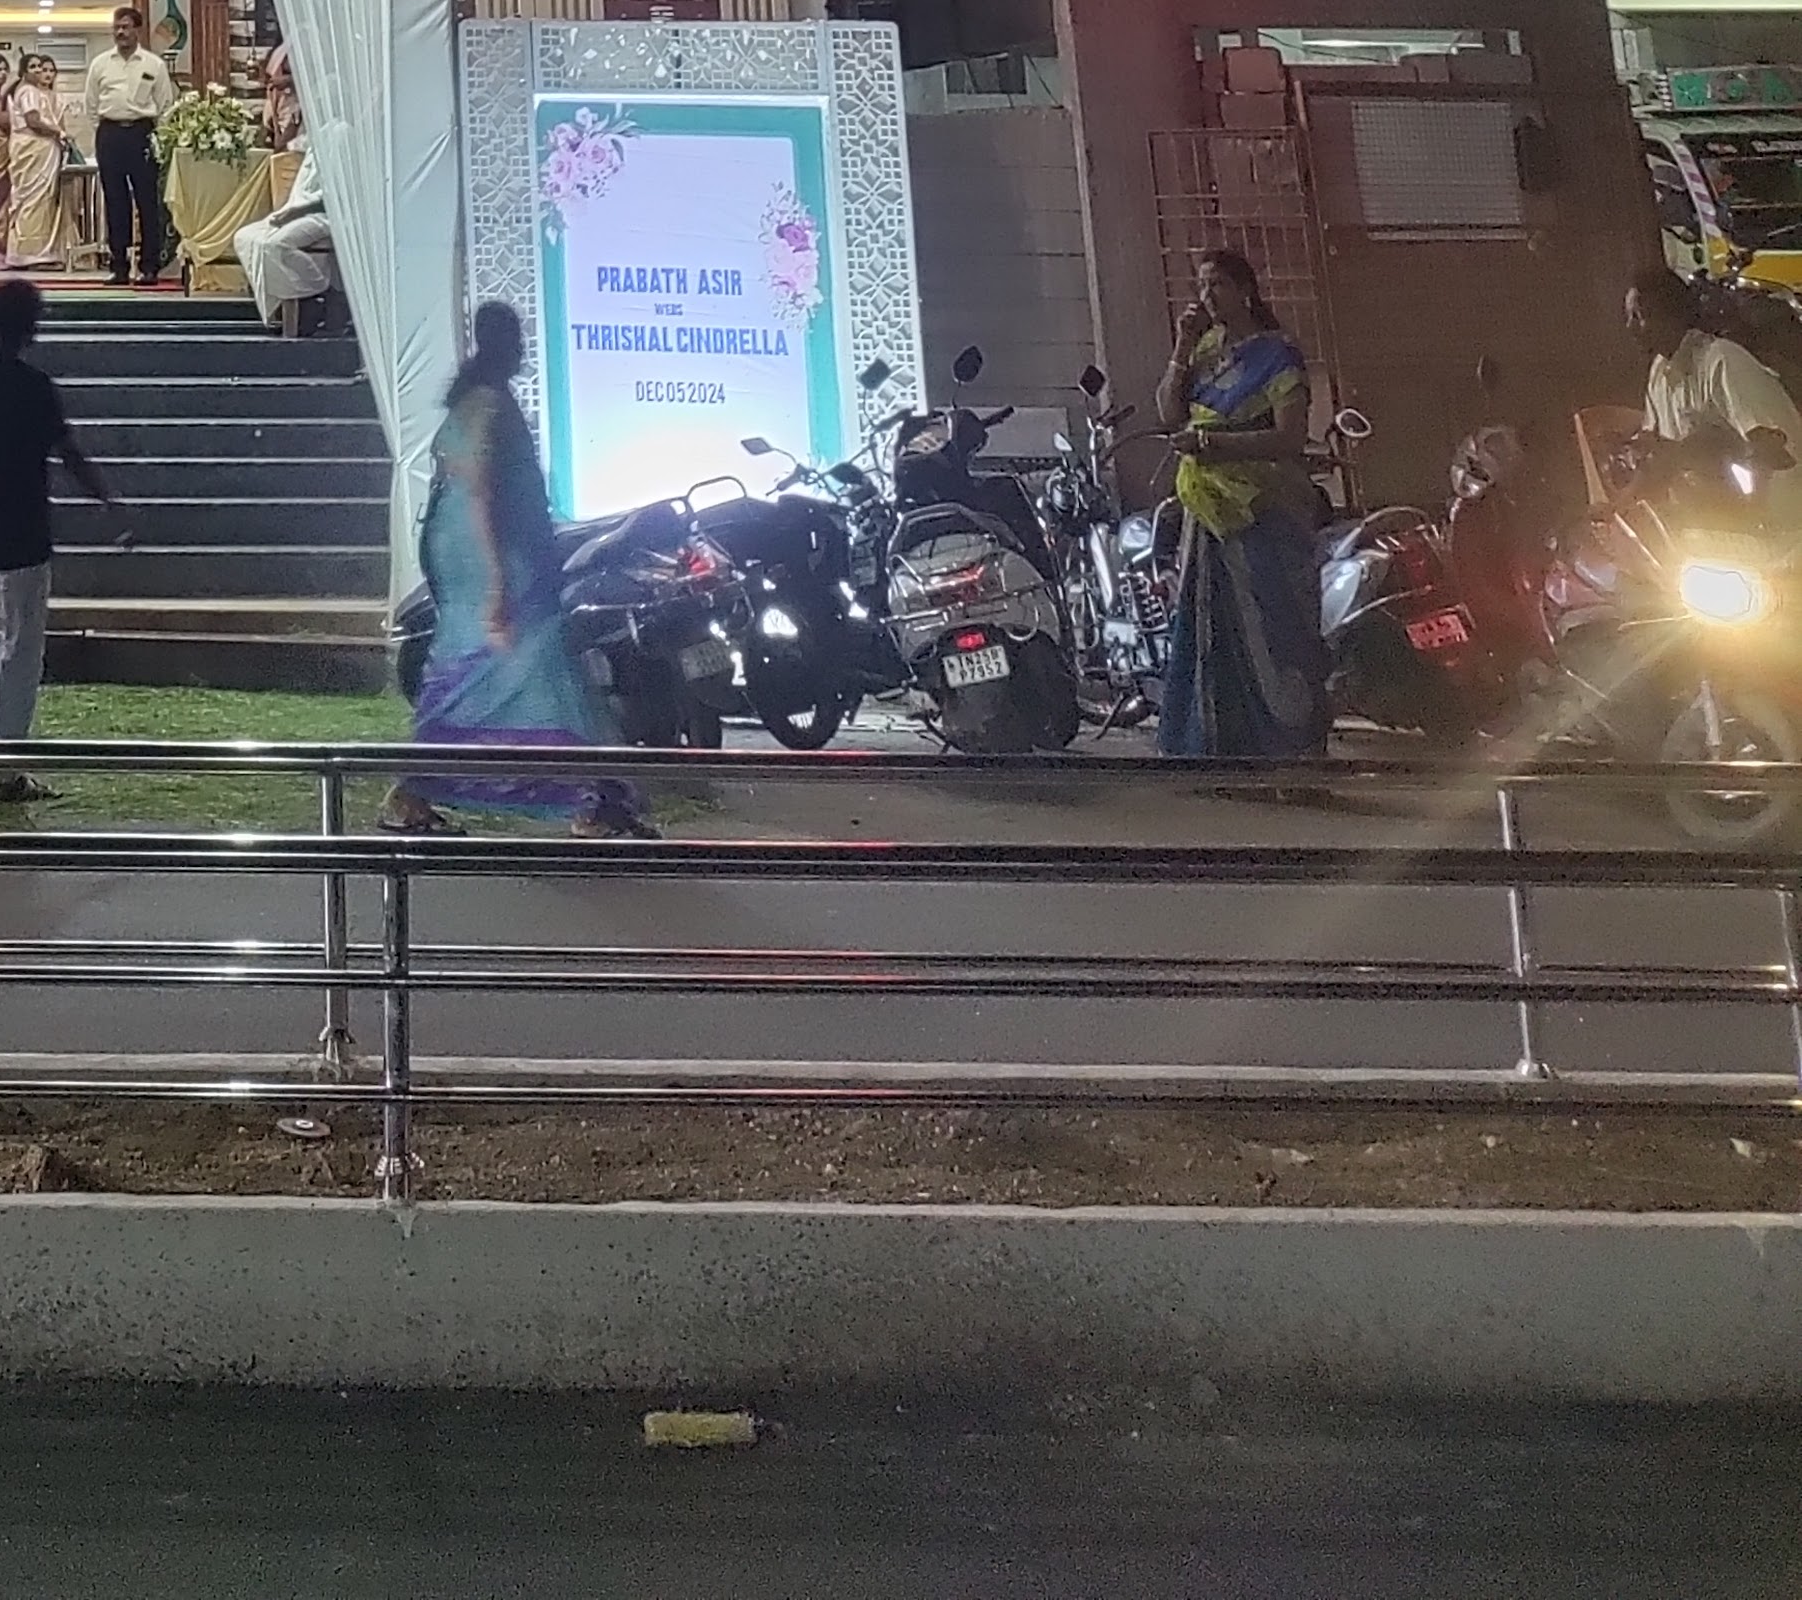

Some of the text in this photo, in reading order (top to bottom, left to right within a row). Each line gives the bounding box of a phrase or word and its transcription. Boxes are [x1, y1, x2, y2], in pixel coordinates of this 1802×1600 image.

[597, 265, 743, 296] PRABATH ASIR
[571, 323, 789, 356] THRISHAL CINDRELLA
